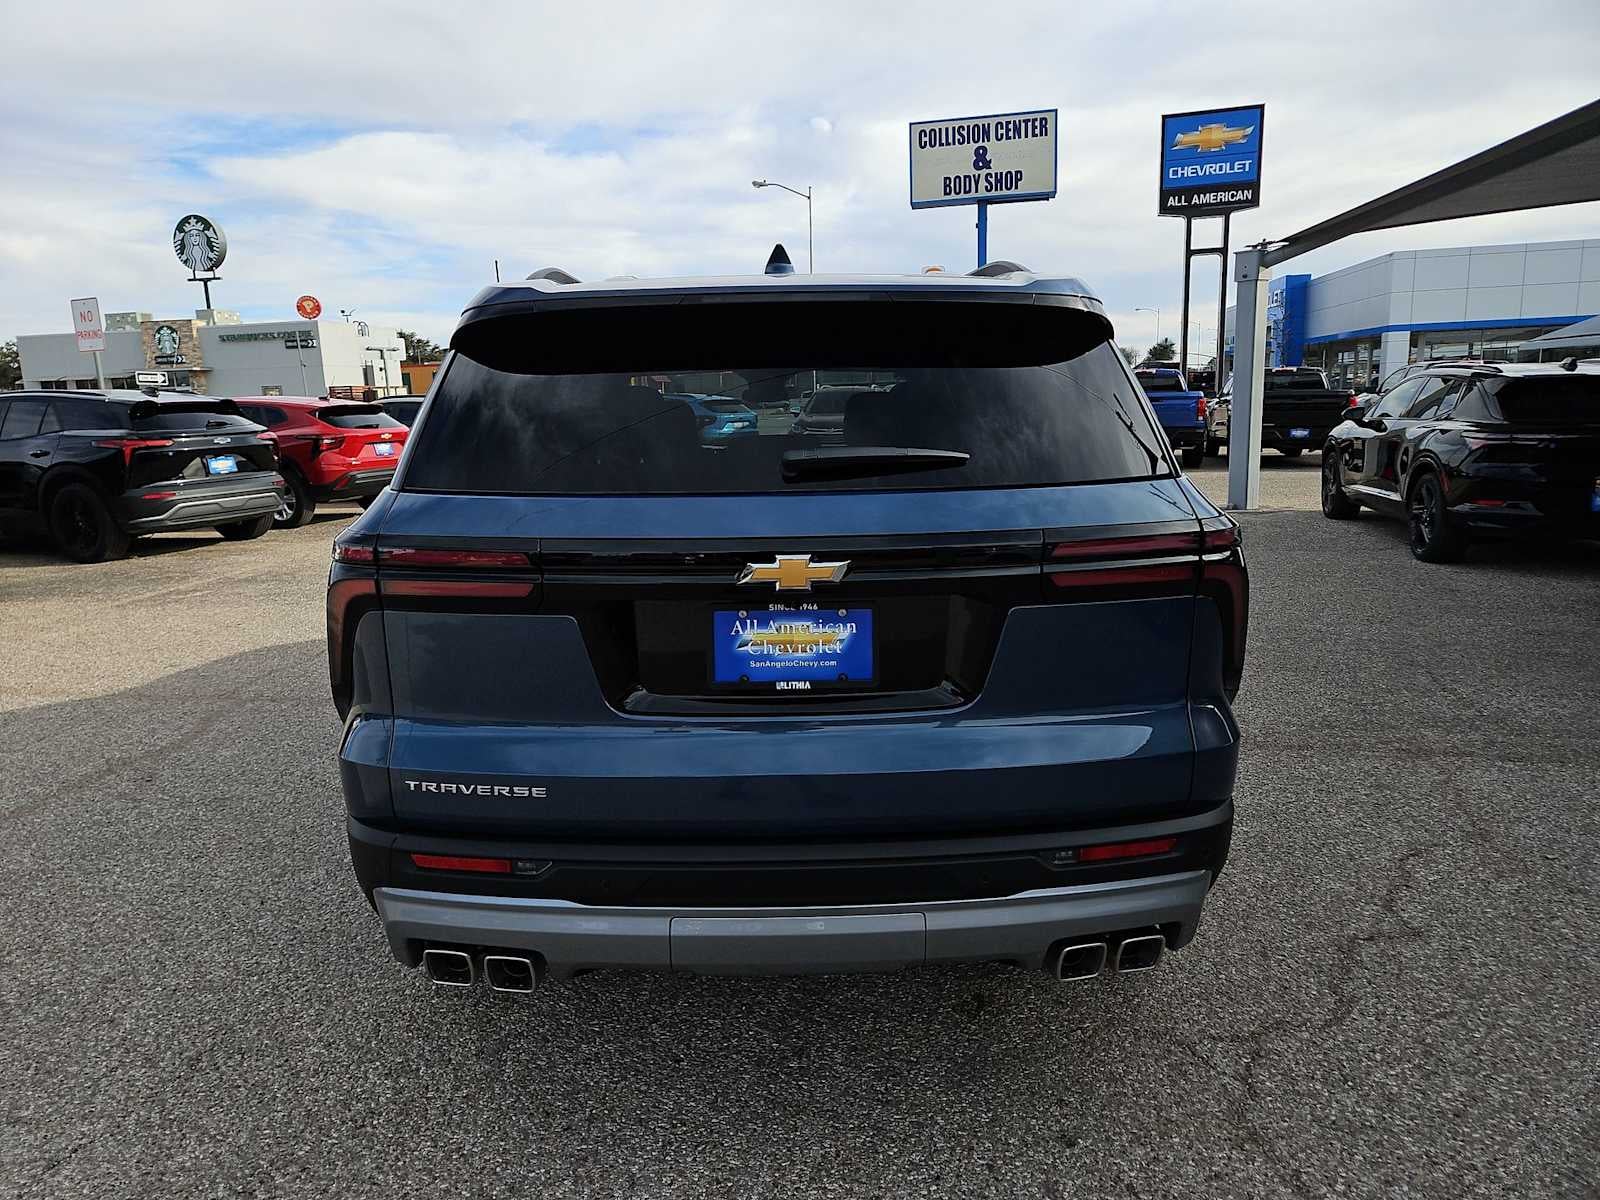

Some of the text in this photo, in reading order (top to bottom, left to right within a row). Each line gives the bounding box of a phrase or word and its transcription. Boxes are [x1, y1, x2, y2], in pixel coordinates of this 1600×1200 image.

[918, 116, 1049, 149] COLLISION CENTER
[973, 145, 992, 171] &
[1168, 160, 1253, 179] CHEVROLET
[943, 170, 1024, 196] BODY SHOP
[1167, 189, 1253, 207] ALL AMERICAN
[79, 310, 94, 323] NO
[77, 327, 103, 339] PARKING
[730, 619, 857, 635] All American
[747, 639, 842, 655] Chevrolet
[751, 660, 837, 668] SanAngeloChevy.com
[404, 780, 548, 798] TRAVERSE
